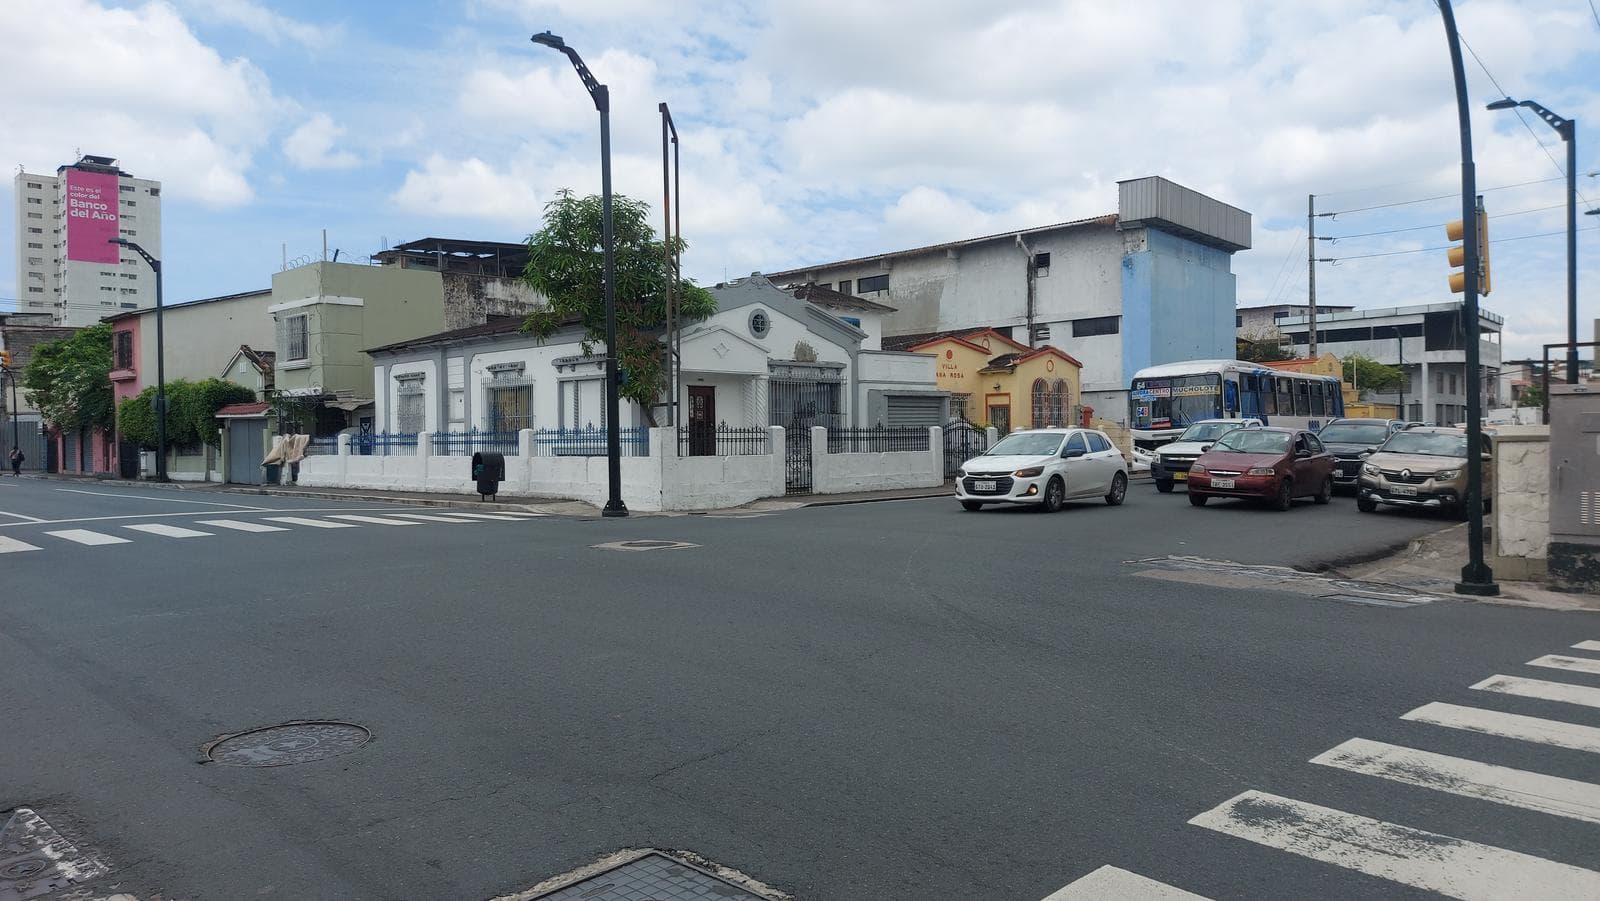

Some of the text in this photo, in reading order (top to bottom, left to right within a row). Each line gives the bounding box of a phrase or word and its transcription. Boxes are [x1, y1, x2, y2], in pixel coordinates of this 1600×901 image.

[70, 199, 108, 211] Banco
[70, 208, 116, 221] del Año
